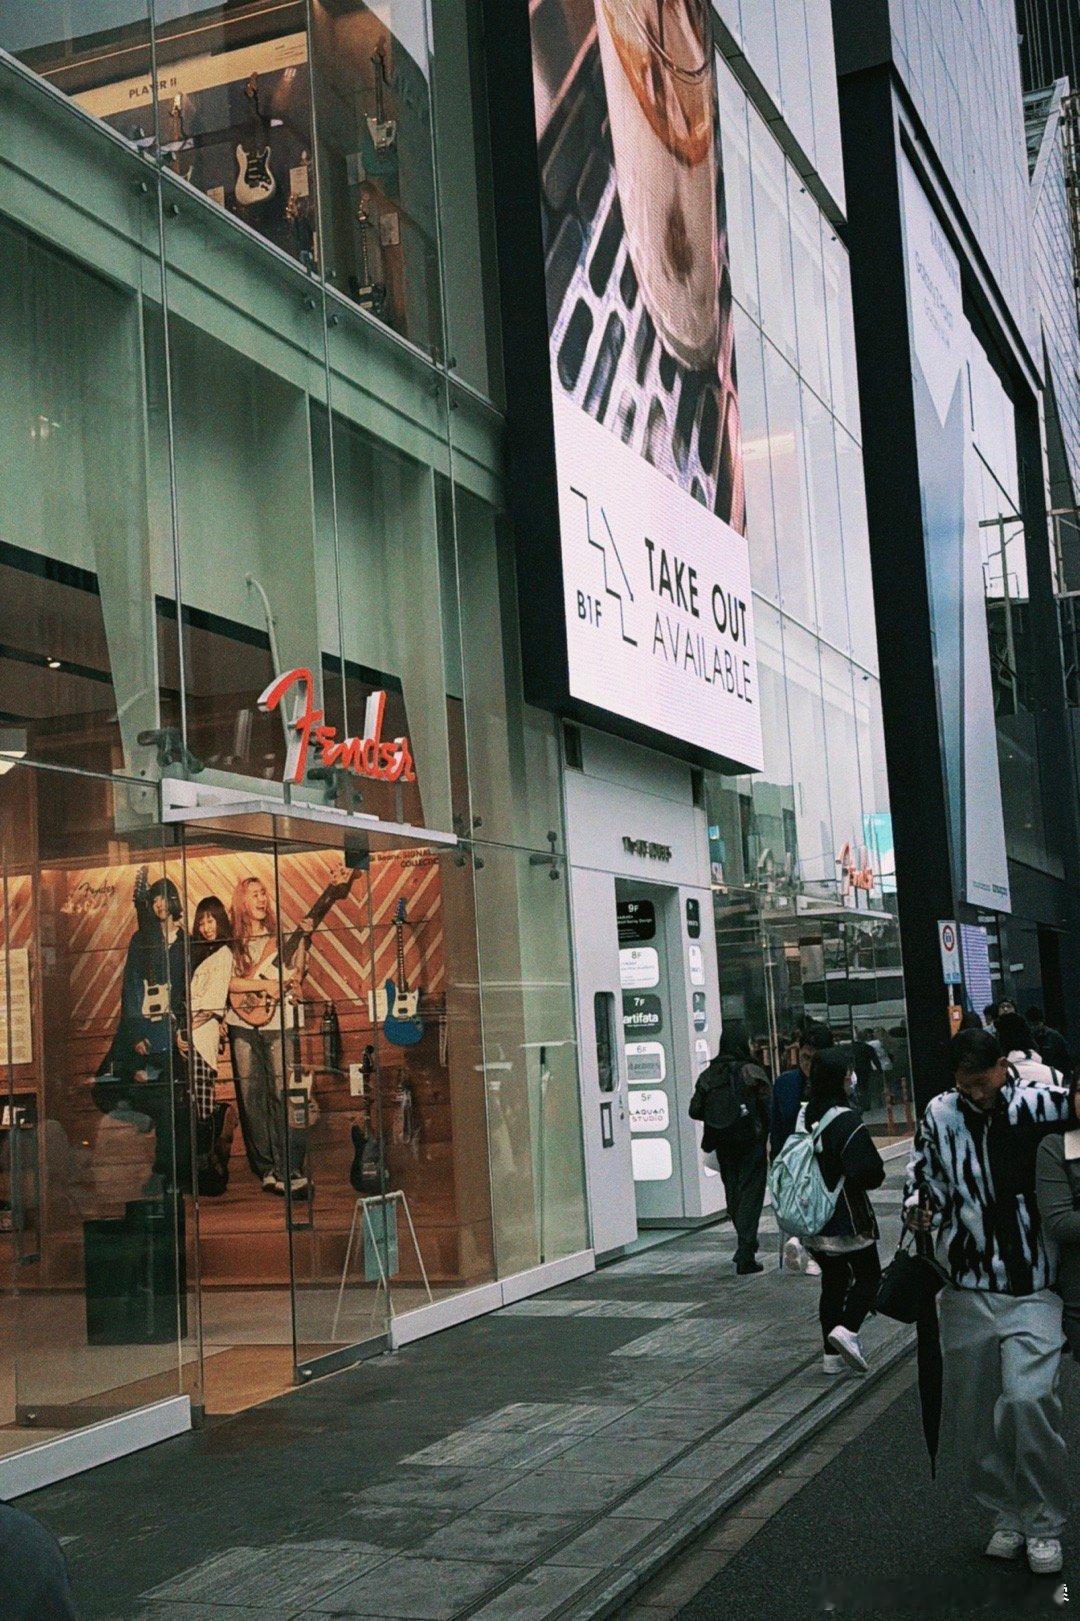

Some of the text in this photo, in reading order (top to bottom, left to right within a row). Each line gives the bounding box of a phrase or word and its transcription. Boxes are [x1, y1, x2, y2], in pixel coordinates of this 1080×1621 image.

[644, 536, 748, 647] TAKE OUT
[576, 589, 603, 628] B1F
[652, 612, 753, 704] AVAILABLE
[256, 667, 415, 784] Fender
[627, 903, 639, 913] 9F
[633, 997, 645, 1006] 7F
[623, 1012, 659, 1024] artifata
[640, 1093, 652, 1102] 5F
